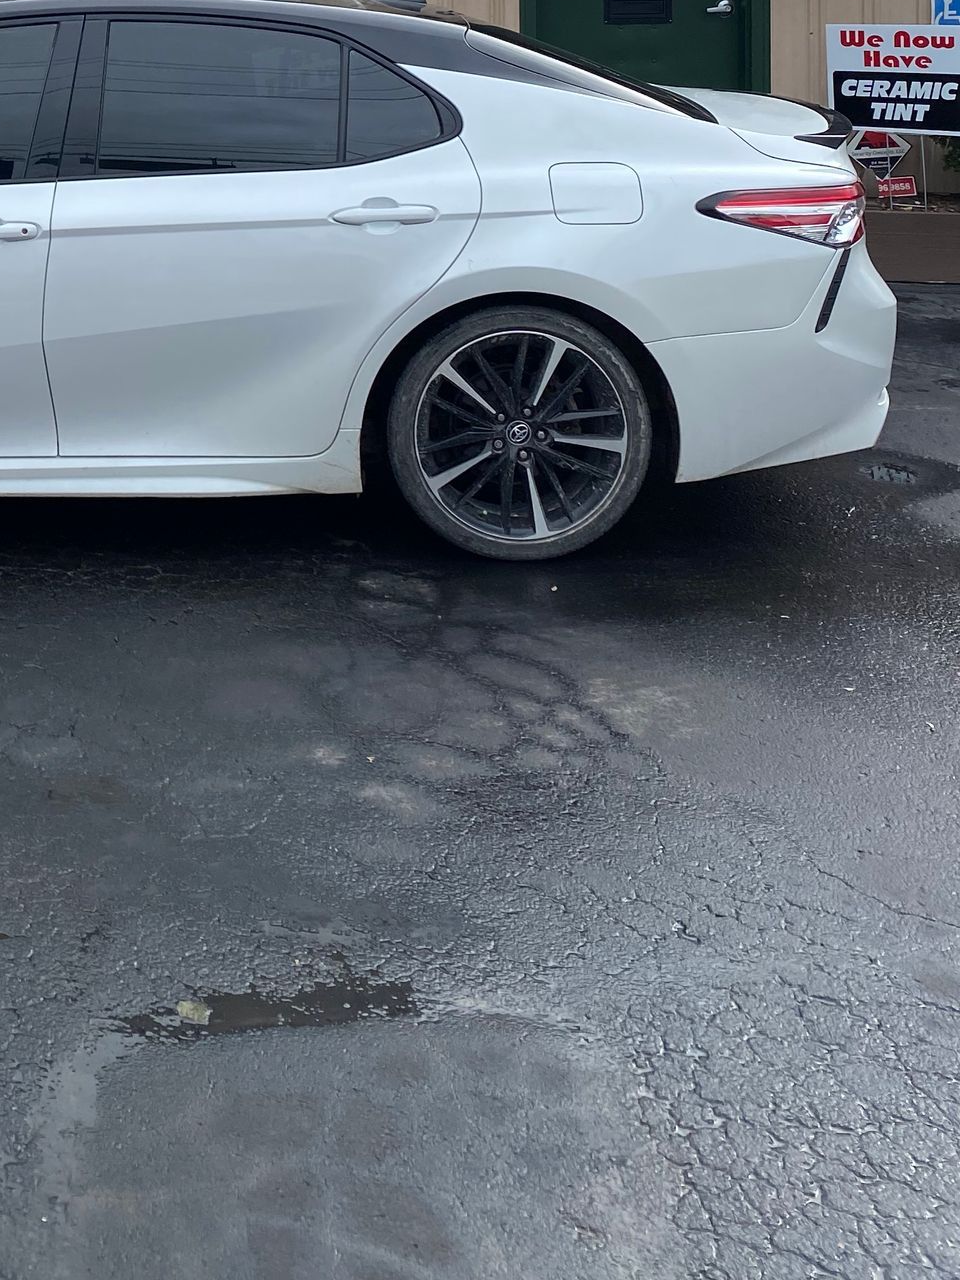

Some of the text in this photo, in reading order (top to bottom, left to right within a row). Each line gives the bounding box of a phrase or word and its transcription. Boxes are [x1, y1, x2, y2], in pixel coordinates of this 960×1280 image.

[840, 30, 955, 49] We Now
[863, 50, 932, 69] Have
[841, 79, 959, 100] CERAMIC
[871, 102, 930, 122] TINT
